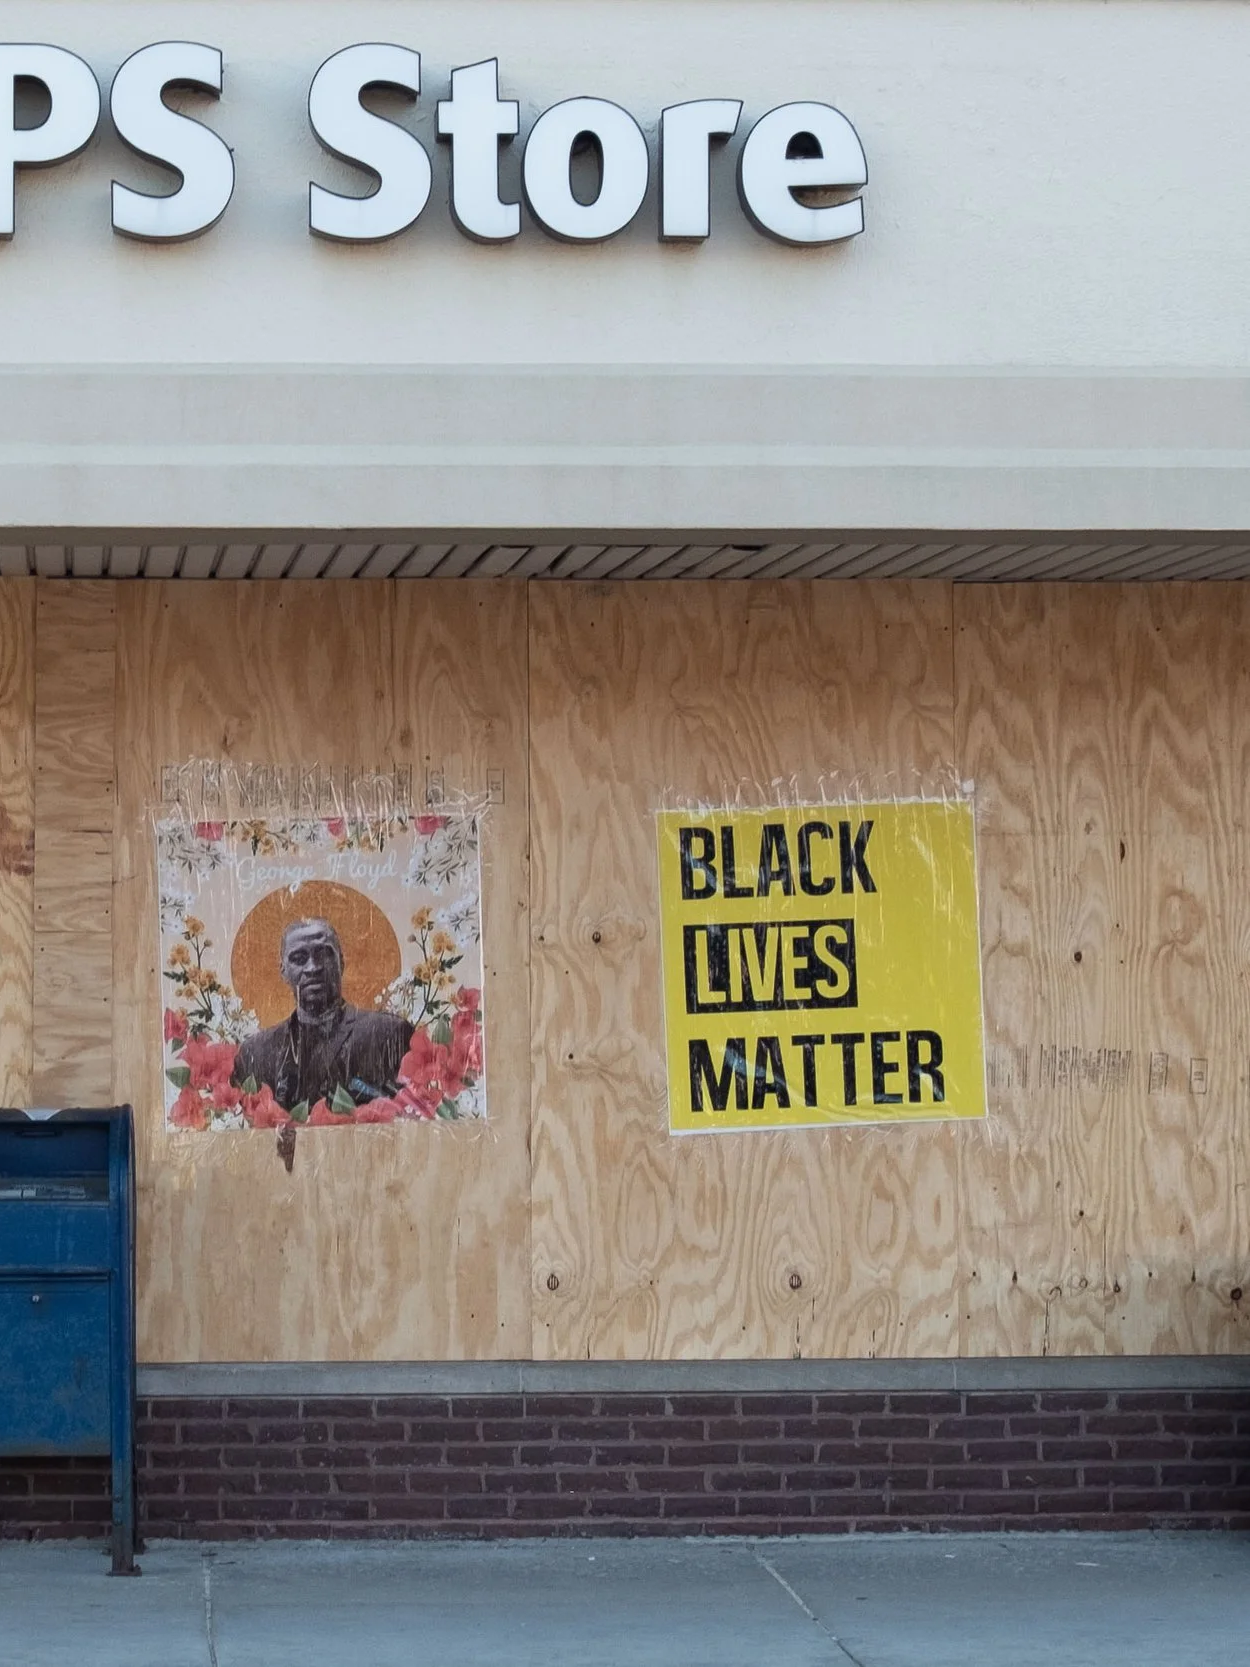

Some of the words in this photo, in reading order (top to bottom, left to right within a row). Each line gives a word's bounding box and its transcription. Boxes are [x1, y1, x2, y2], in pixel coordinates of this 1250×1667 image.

[307, 41, 868, 246] Store
[236, 856, 316, 896] George
[324, 851, 398, 889] Floyd
[679, 820, 877, 900] BLACK
[695, 923, 851, 1004] LIVES
[688, 1030, 946, 1113] MATTER
